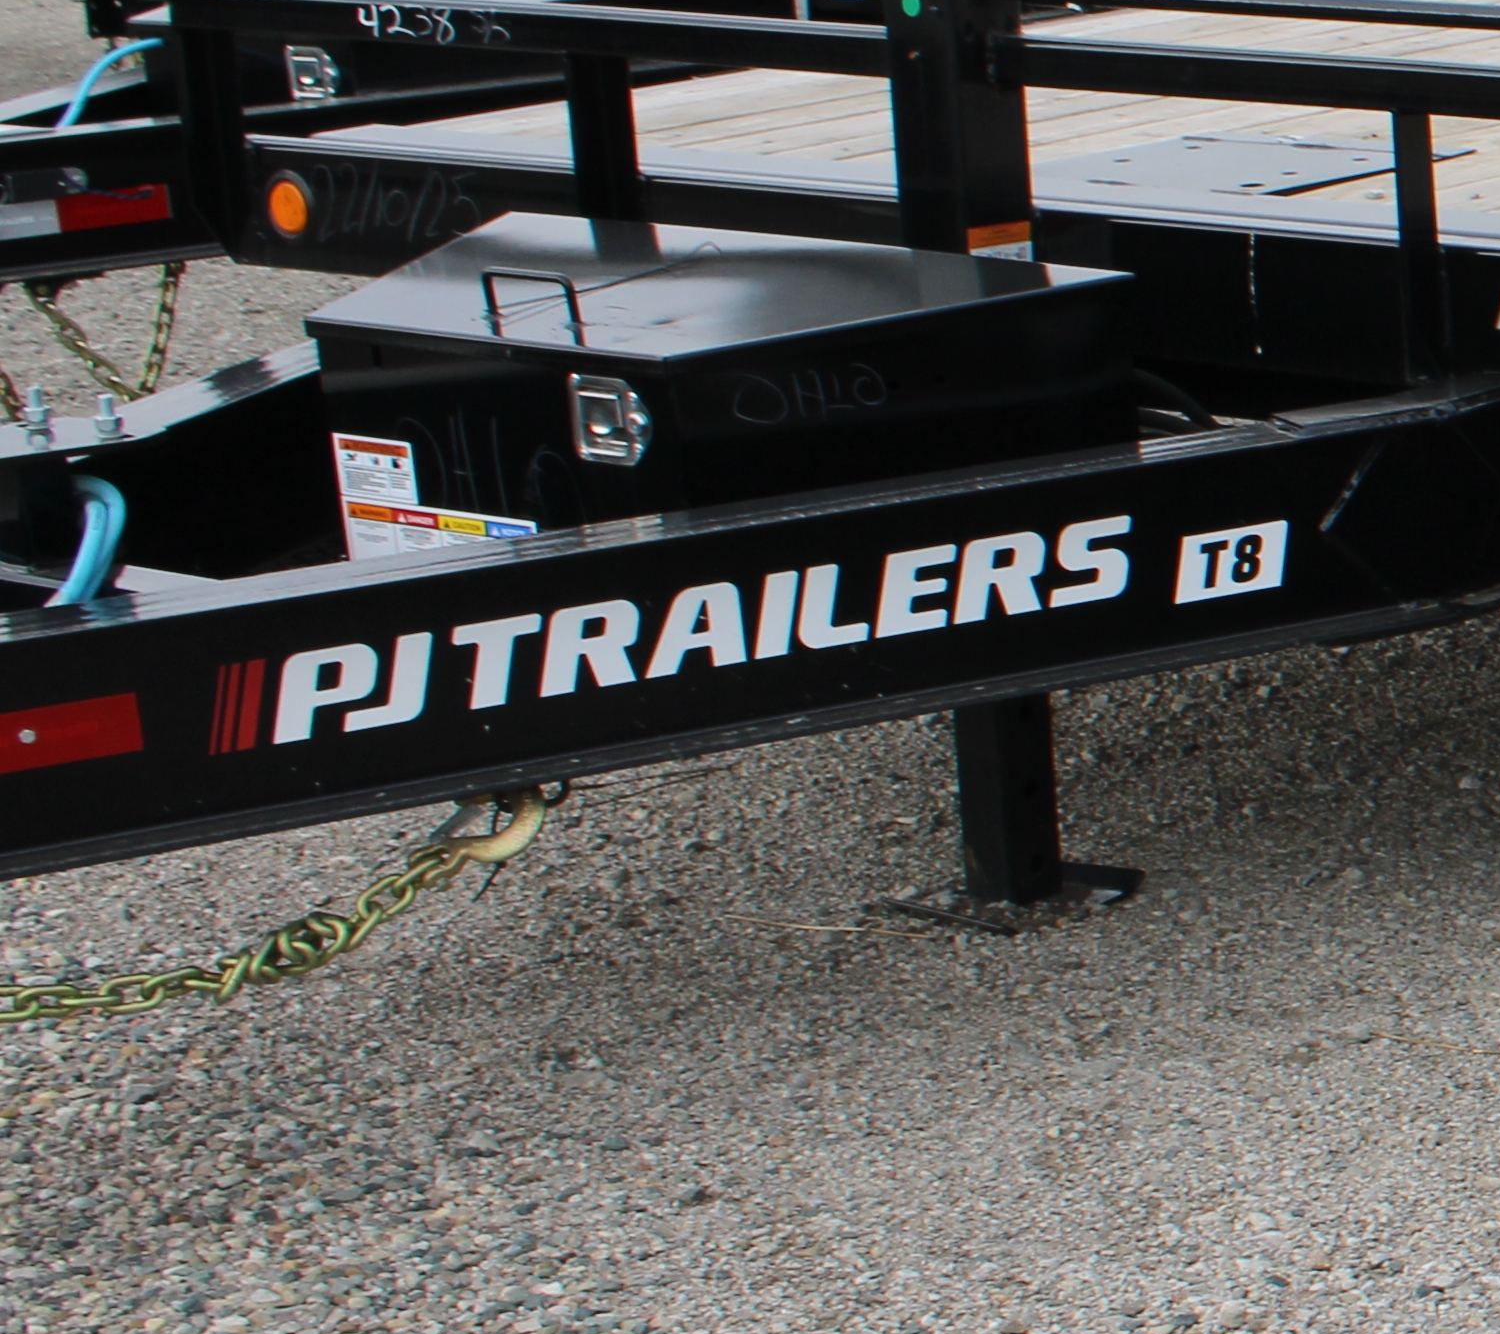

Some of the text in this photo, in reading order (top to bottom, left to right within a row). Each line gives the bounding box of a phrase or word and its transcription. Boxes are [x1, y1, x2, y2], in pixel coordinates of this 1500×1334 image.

[270, 514, 1263, 745] PJ TRAILERS T8
